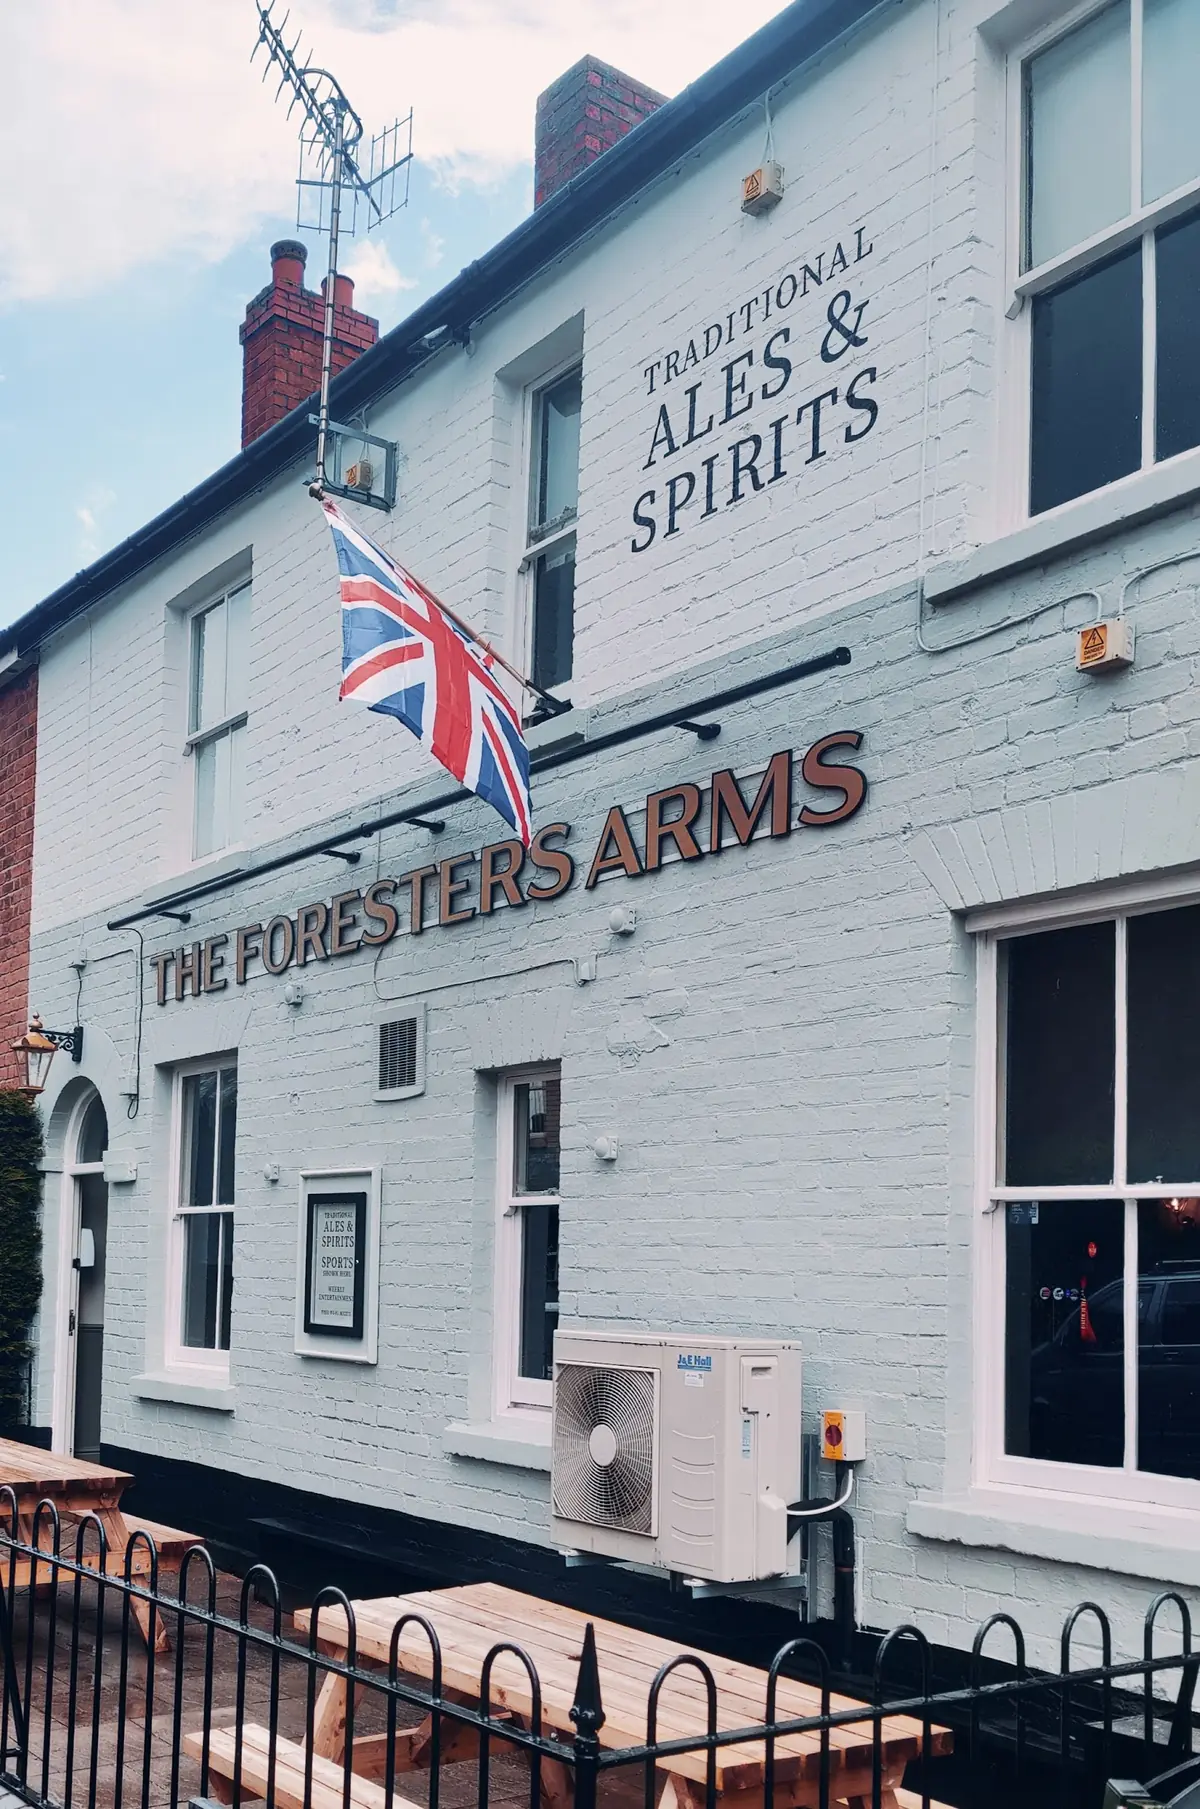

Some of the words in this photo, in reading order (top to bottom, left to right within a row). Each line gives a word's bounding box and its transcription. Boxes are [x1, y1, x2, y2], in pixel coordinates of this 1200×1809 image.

[643, 226, 873, 396] TRADITIONAL
[642, 328, 792, 470] ALES
[820, 290, 870, 363] &
[631, 367, 879, 553] SPIRITS
[150, 934, 228, 1006] THE
[235, 822, 574, 985] FORESTERS
[585, 730, 867, 890] ARMS
[321, 1235, 355, 1248] SPIRITS
[321, 1256, 354, 1269] SPORTS
[323, 1220, 345, 1232] ALES
[347, 1220, 354, 1233] &
[677, 1354, 693, 1365] J&E
[694, 1355, 712, 1366] Hall
